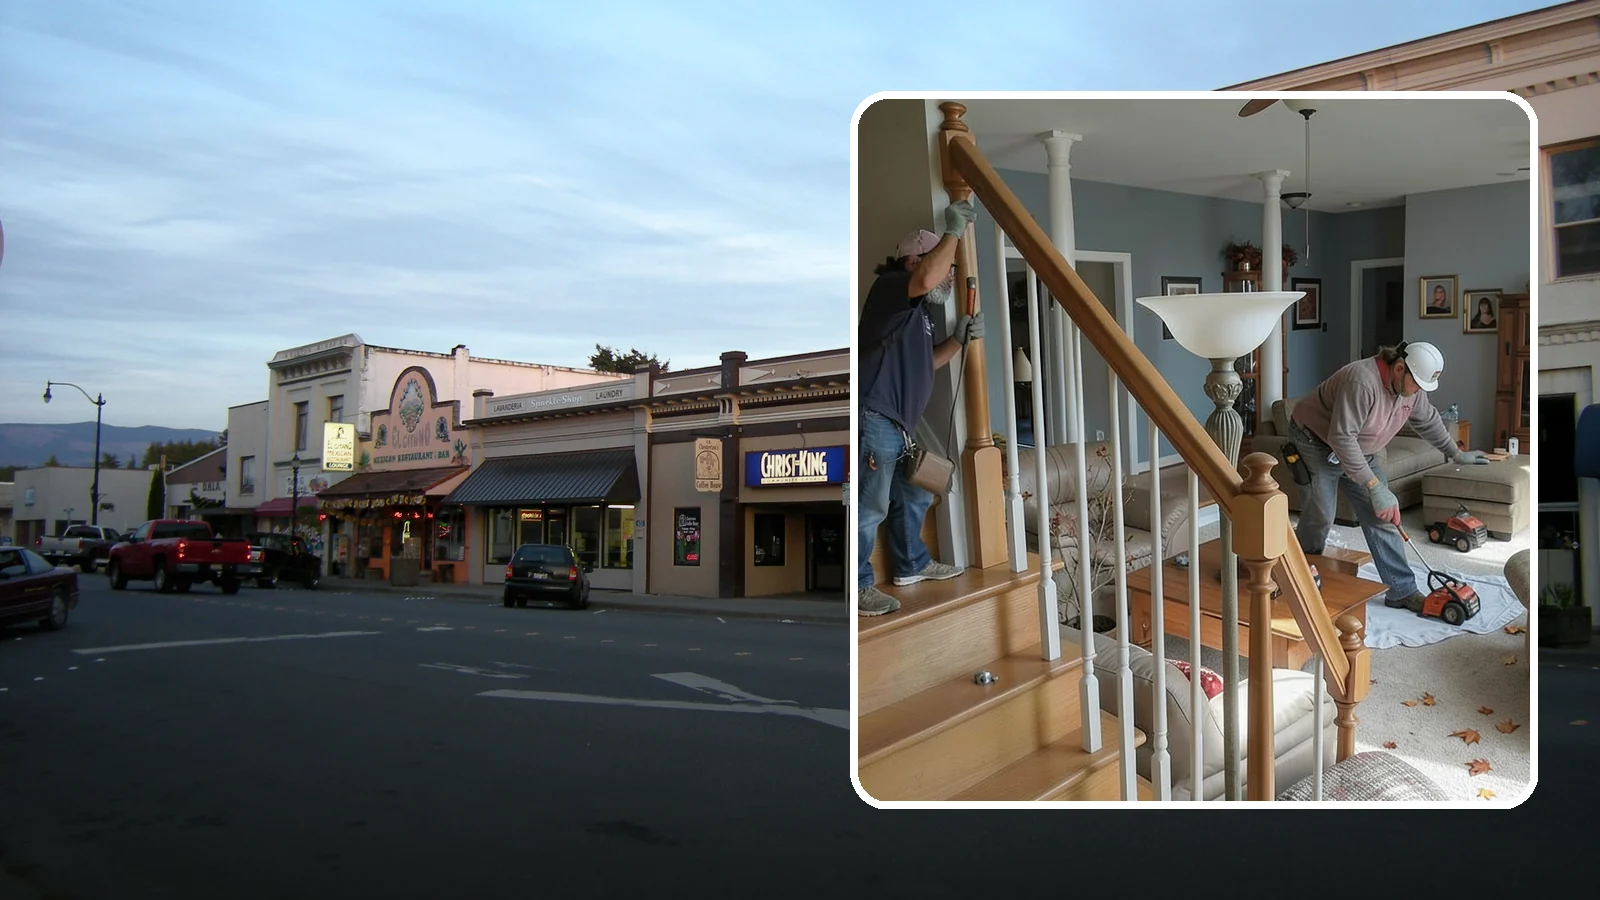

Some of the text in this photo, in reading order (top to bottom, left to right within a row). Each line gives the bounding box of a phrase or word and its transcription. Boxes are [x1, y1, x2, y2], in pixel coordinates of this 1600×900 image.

[494, 389, 623, 412] LAVANDERIA Sparkle Shop LAUNDRY
[373, 450, 450, 464] MEXICAN RESTAURANT BAR
[761, 450, 827, 478] CHRIST KING
[697, 481, 721, 489] Coffee House
